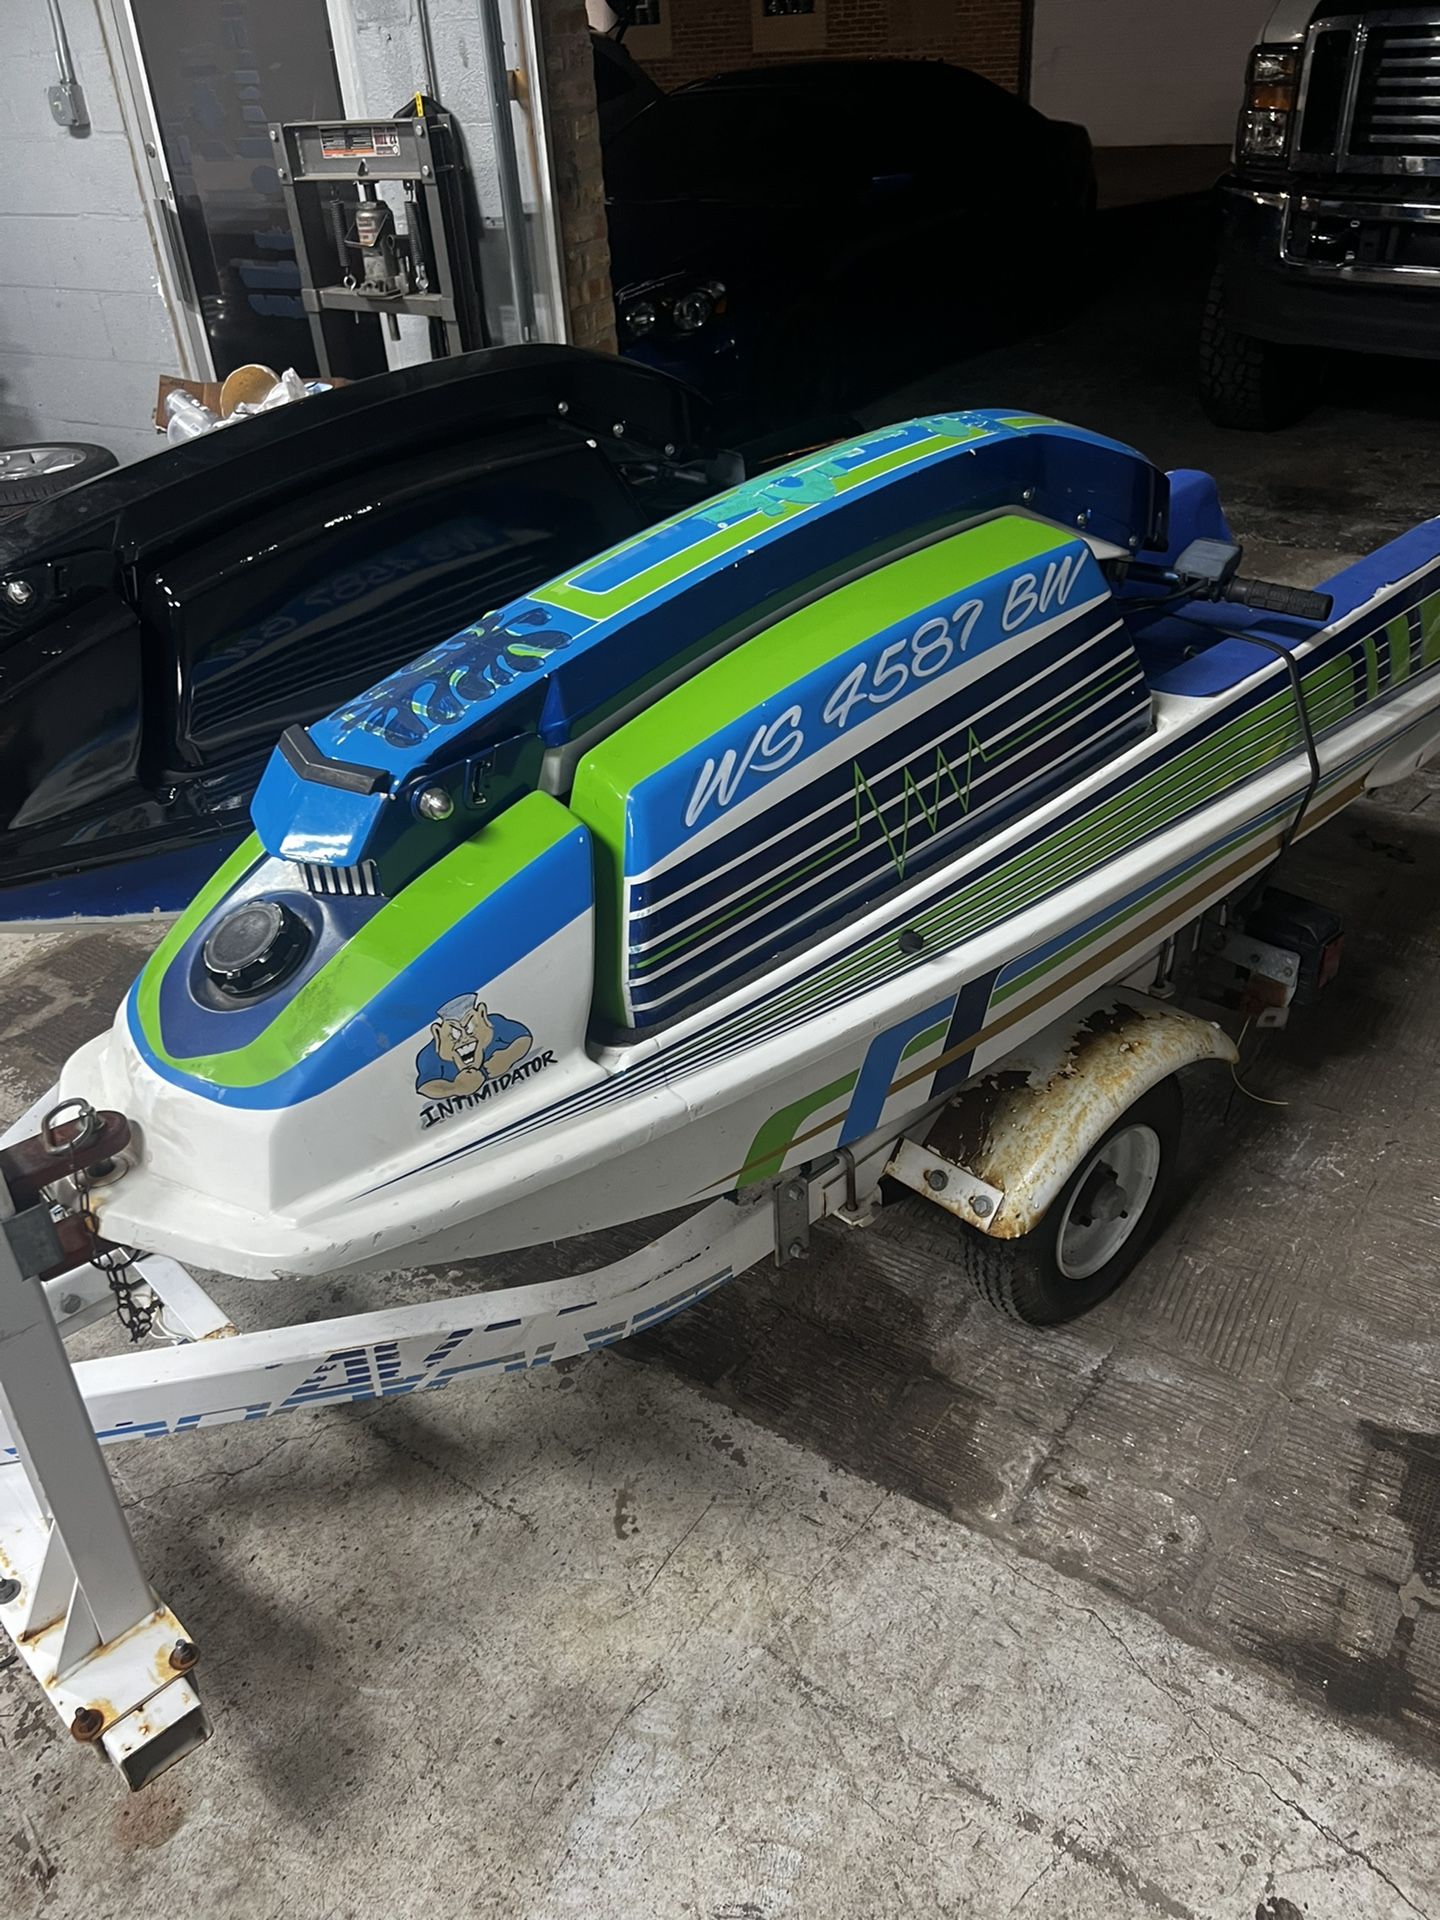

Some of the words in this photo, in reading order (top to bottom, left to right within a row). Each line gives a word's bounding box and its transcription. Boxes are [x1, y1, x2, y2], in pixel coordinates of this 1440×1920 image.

[684, 703, 805, 828] WS
[822, 598, 985, 728] 4587
[1001, 548, 1090, 632] BW
[419, 1049, 559, 1128] INTIMIDATOR
